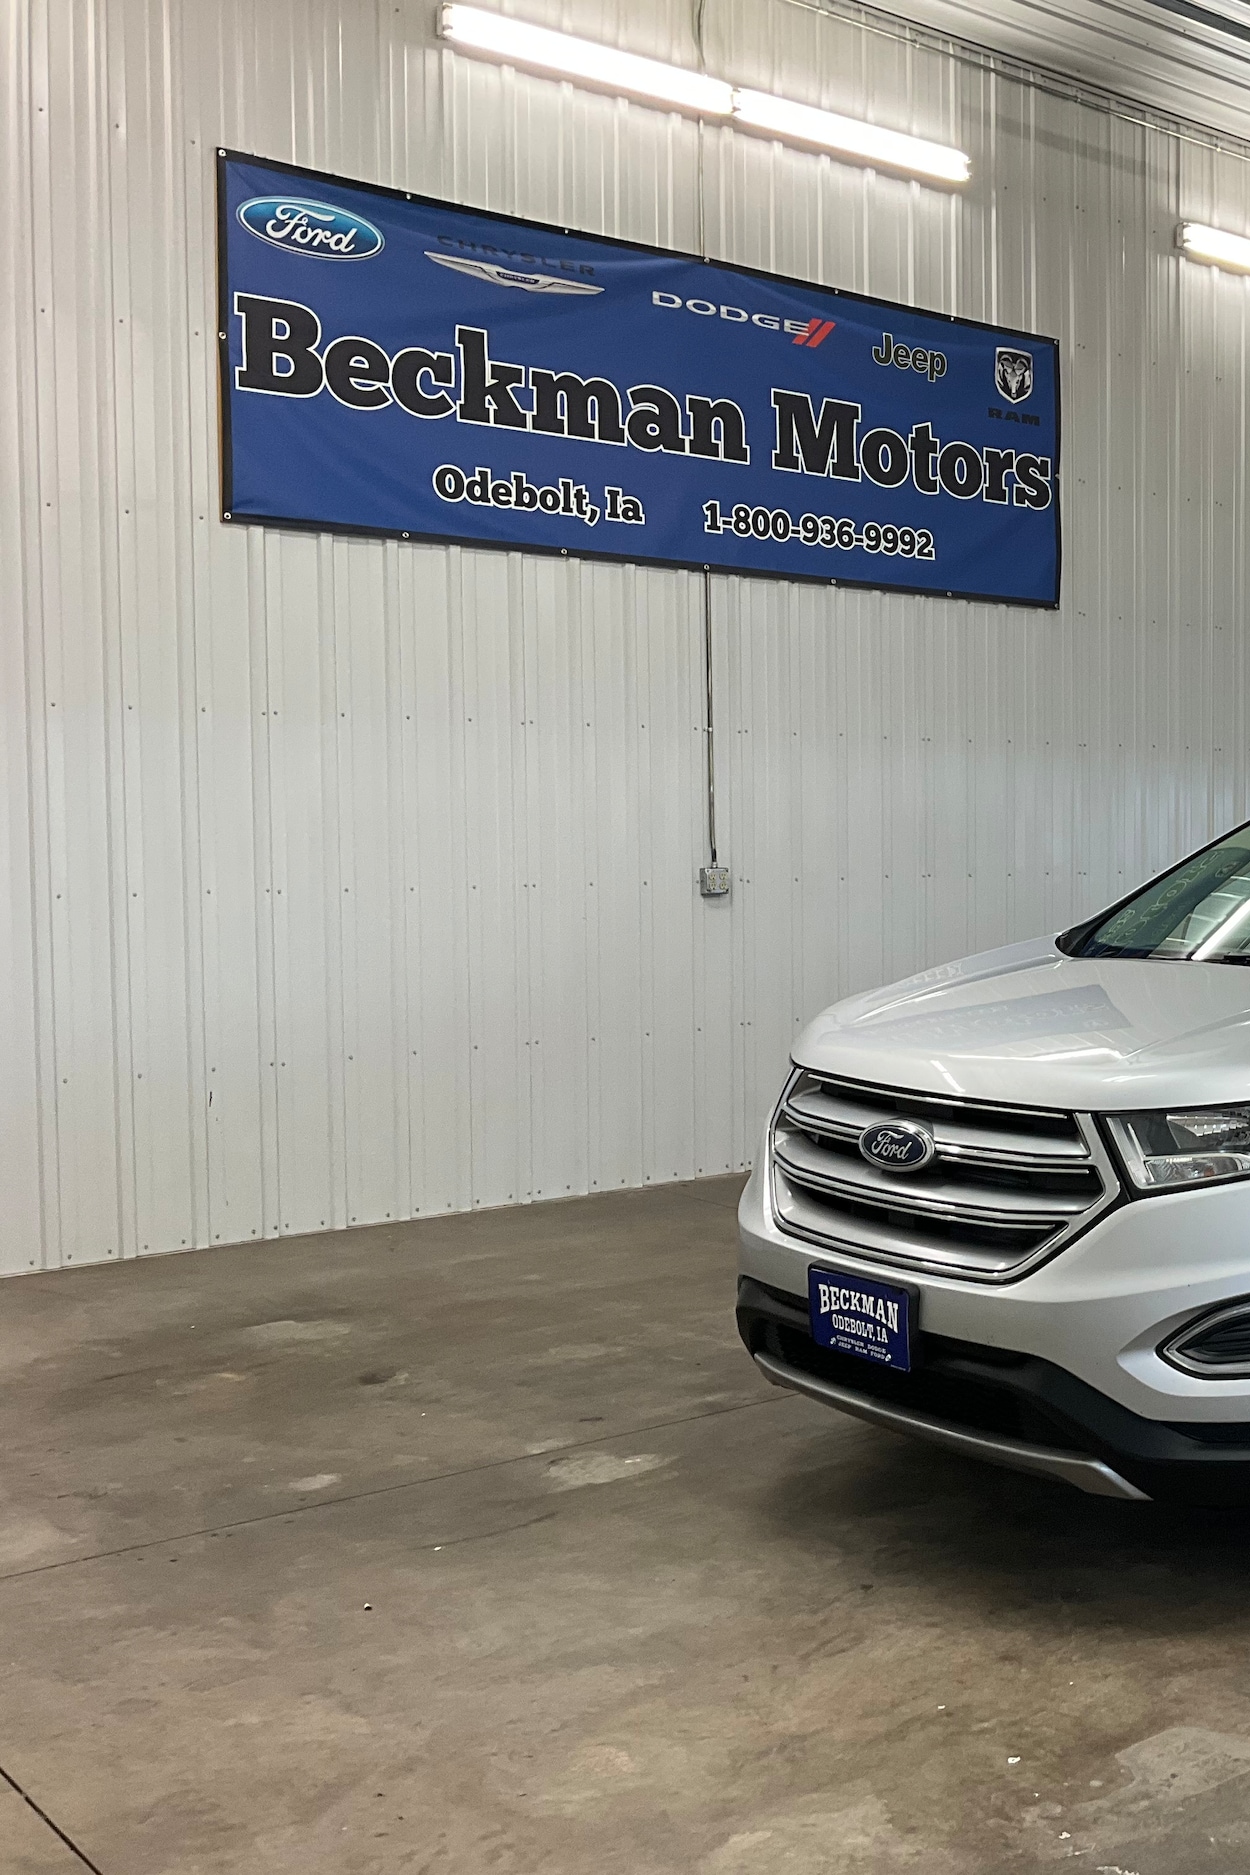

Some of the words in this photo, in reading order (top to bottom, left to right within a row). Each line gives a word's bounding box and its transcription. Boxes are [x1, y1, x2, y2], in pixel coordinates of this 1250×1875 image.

[266, 198, 356, 253] Ford
[437, 235, 596, 276] CHRYSLER
[652, 290, 810, 336] DODGE
[872, 333, 947, 382] Jeep
[234, 292, 750, 465] Beckman
[771, 388, 1051, 510] Motors
[987, 407, 1040, 426] RAM
[433, 464, 600, 526] Odebolt,
[605, 486, 646, 525] Ia
[703, 501, 935, 560] 1-800-936-9992
[871, 1130, 913, 1160] Ford
[818, 1283, 899, 1334] BECKMAN
[832, 1313, 876, 1341] ODEBOLT,
[877, 1326, 888, 1343] IA
